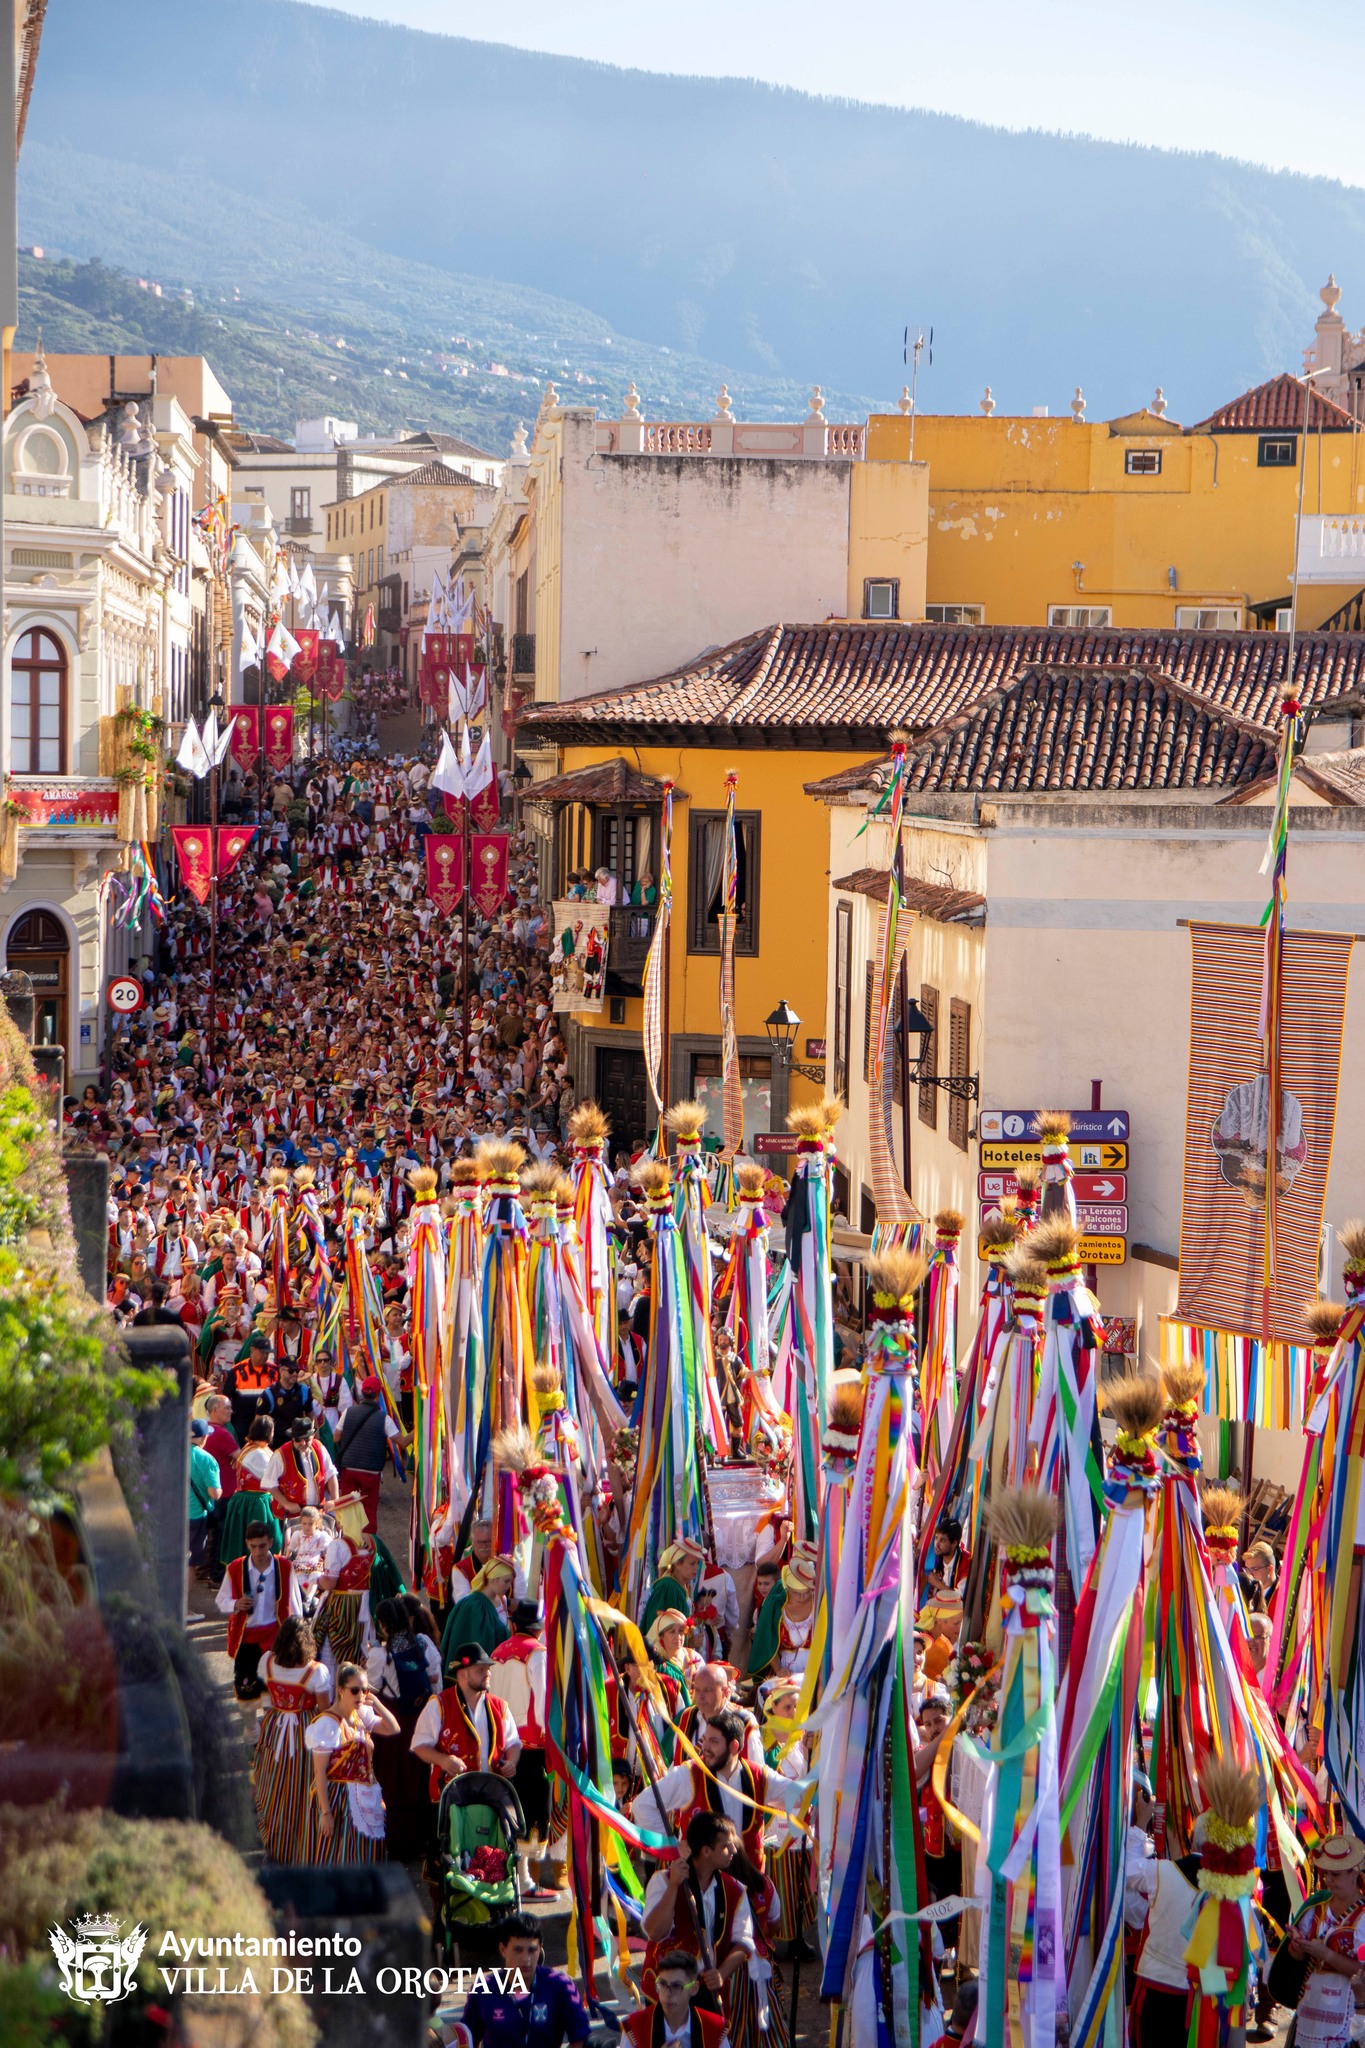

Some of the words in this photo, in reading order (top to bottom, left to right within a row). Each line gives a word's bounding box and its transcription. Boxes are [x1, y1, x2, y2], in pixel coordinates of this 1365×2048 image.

[115, 988, 136, 1001] 20
[1072, 1122, 1103, 1131] Turística
[984, 1150, 1041, 1161] Hoteles
[1085, 1215, 1121, 1223] Balcones
[1100, 1223, 1121, 1231] gofio
[1079, 1250, 1121, 1260] Orotava
[926, 1901, 954, 1919] 2016
